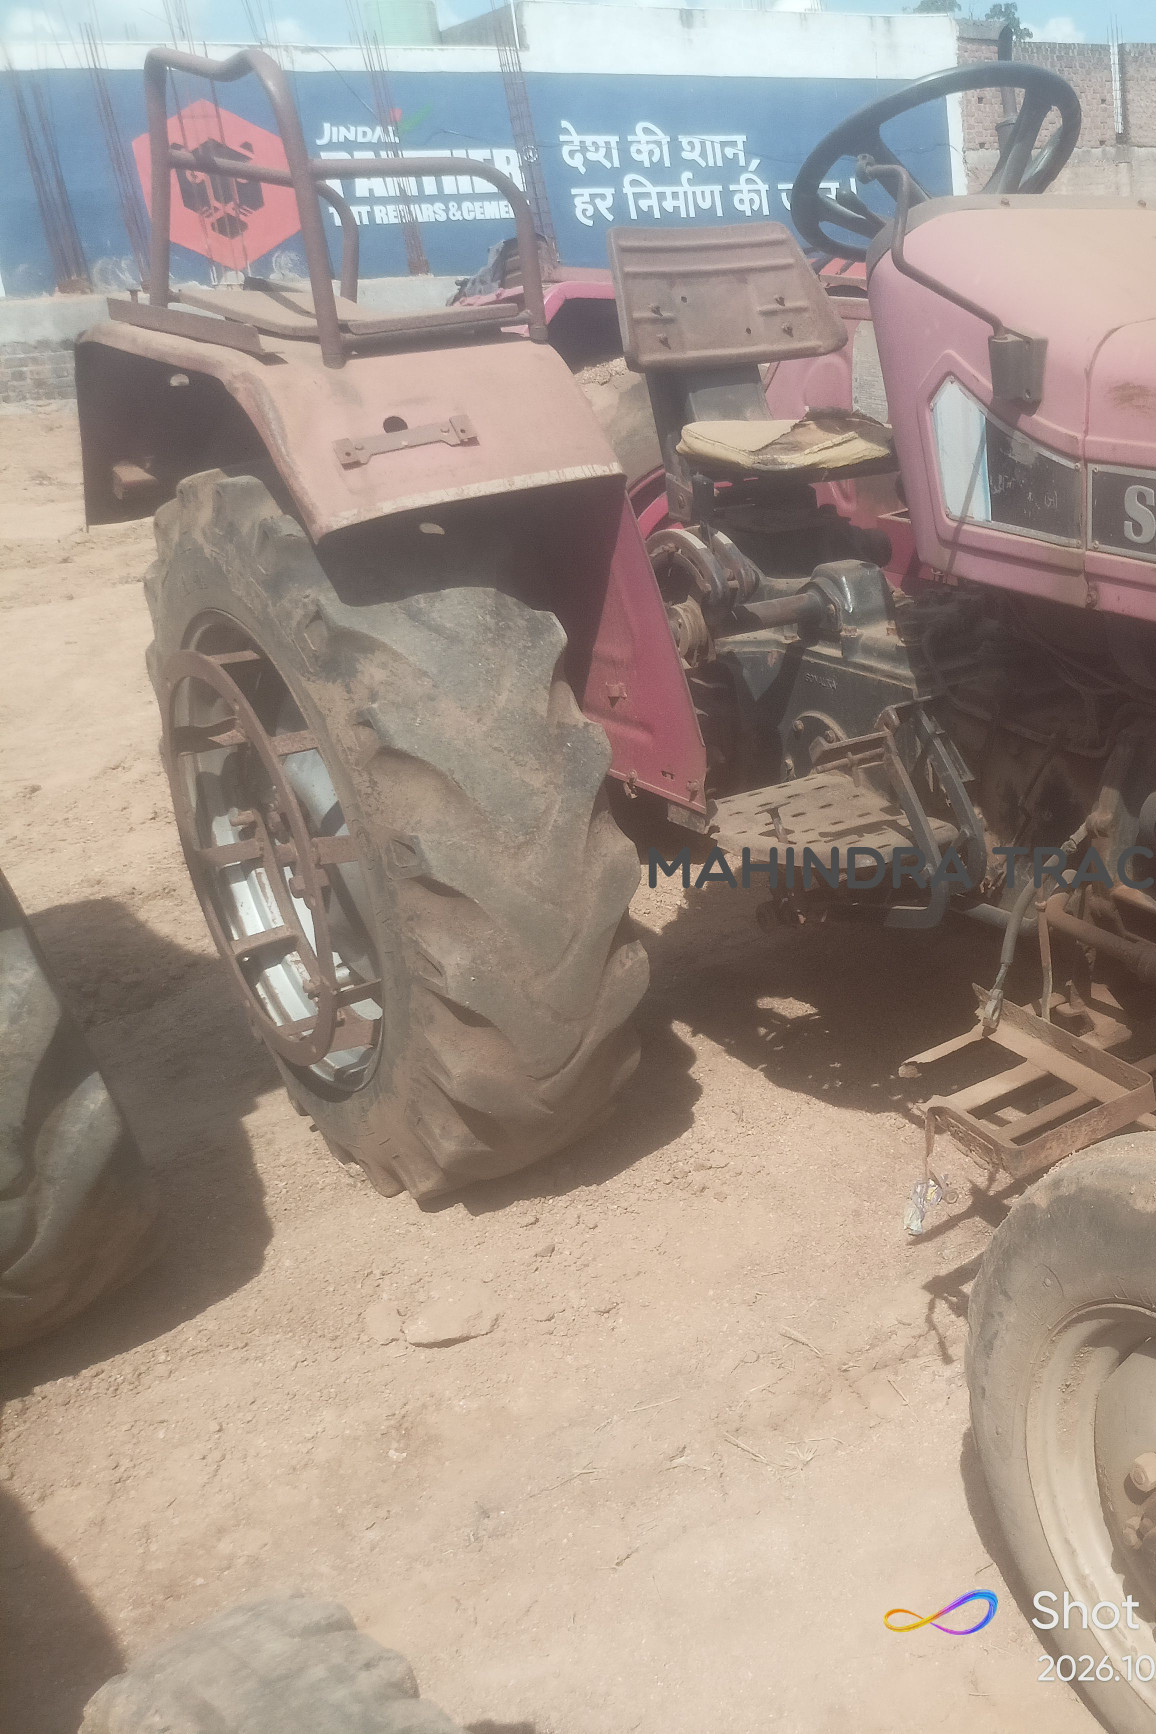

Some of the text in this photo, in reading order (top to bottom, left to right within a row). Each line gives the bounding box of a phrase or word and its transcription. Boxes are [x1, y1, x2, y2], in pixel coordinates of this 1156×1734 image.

[316, 122, 399, 145] JINDAL
[559, 120, 620, 174] देश
[628, 121, 671, 167] की
[328, 204, 370, 227] TT
[571, 188, 615, 226] हर
[622, 171, 723, 219] निर्माण
